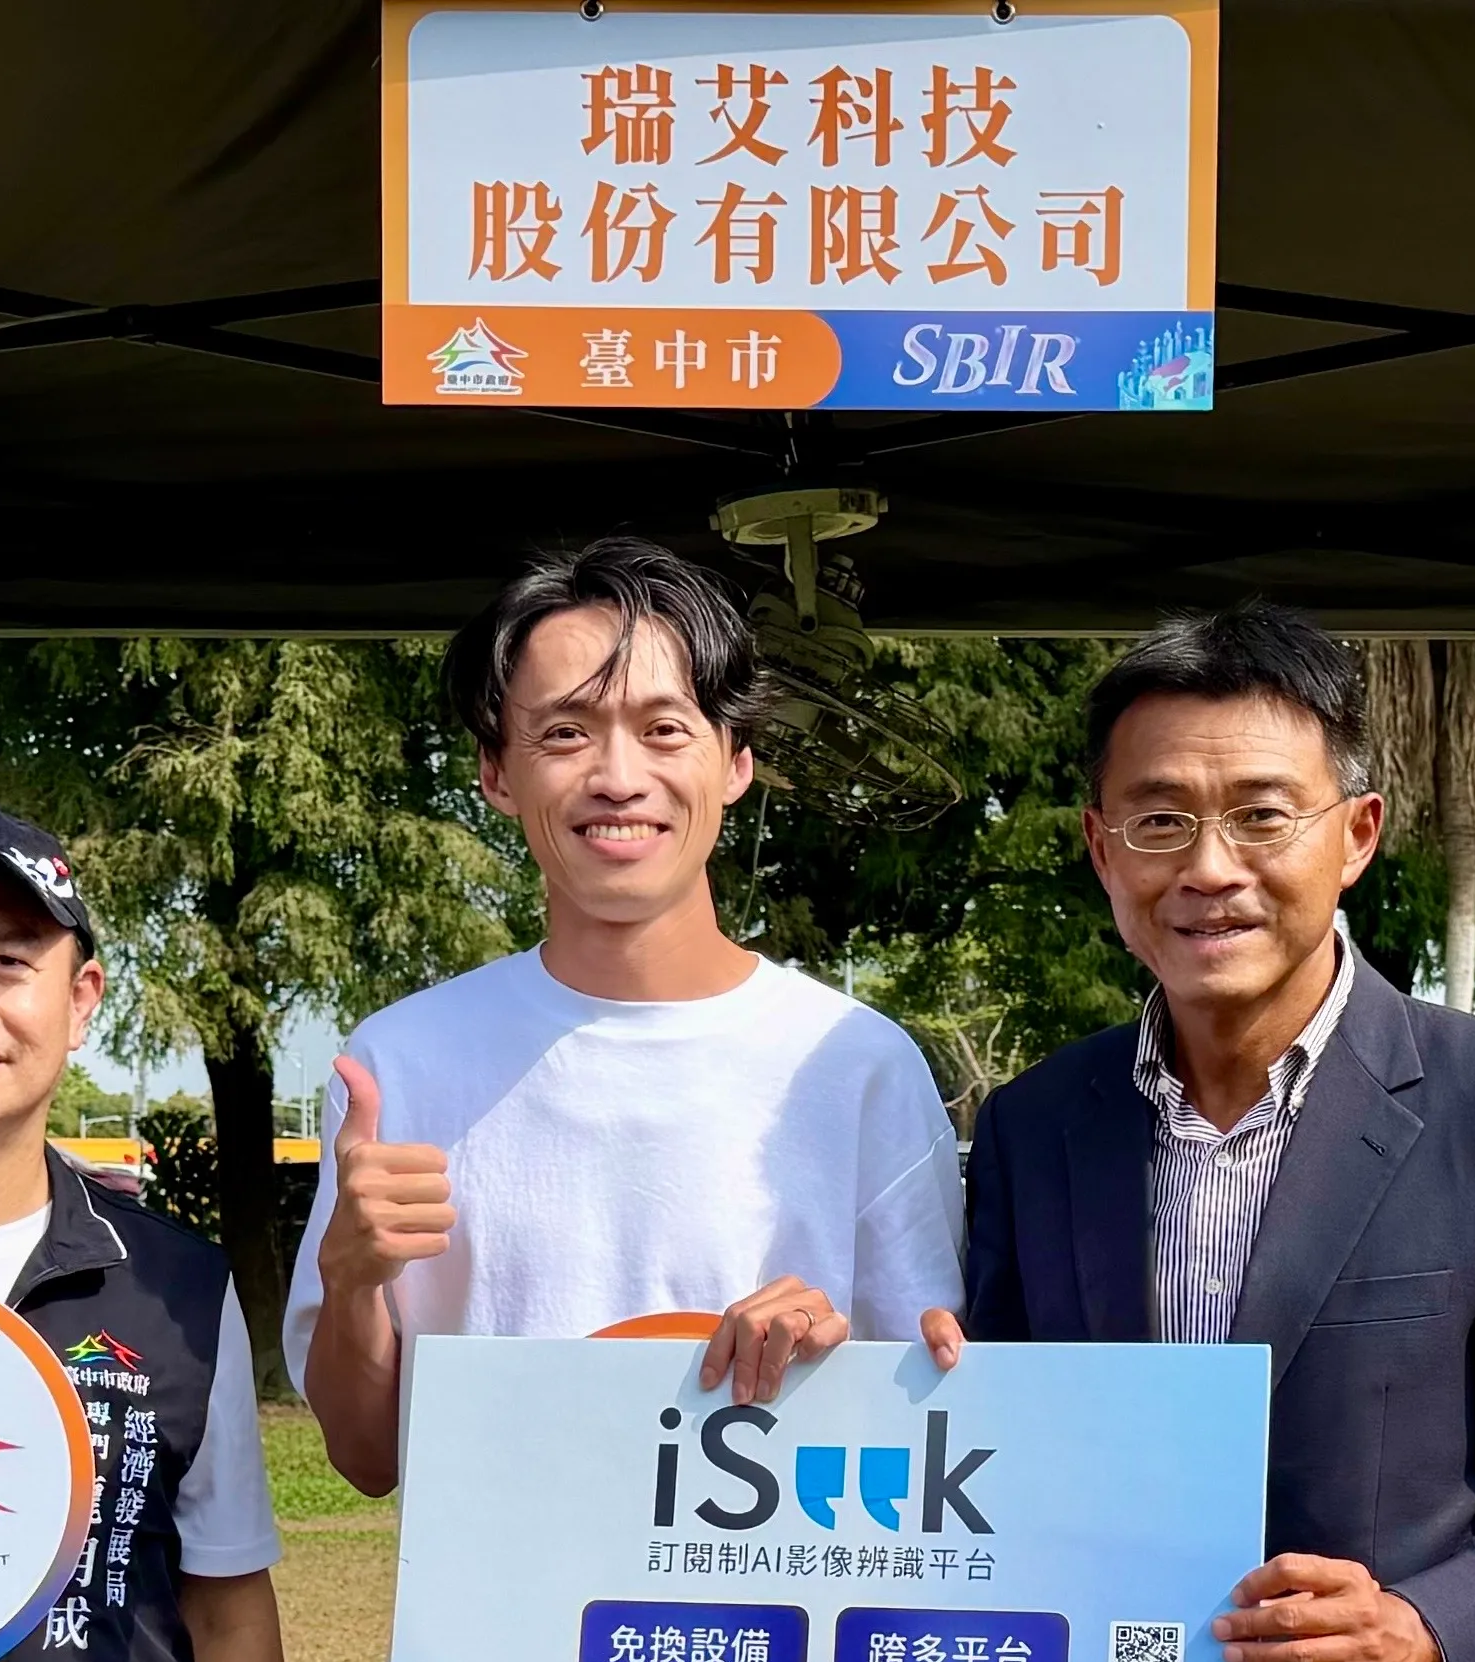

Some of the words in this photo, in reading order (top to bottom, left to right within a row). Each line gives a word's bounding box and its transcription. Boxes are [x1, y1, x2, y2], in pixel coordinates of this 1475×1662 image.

[580, 63, 1018, 168] 瑞艾科技
[466, 179, 1126, 287] 股份有限公司
[578, 328, 780, 391] 臺中市
[892, 322, 1078, 396] SBIR
[105, 1405, 158, 1608] 經濟發展局
[646, 1538, 998, 1583] 訂閱制AI影像辨識平台
